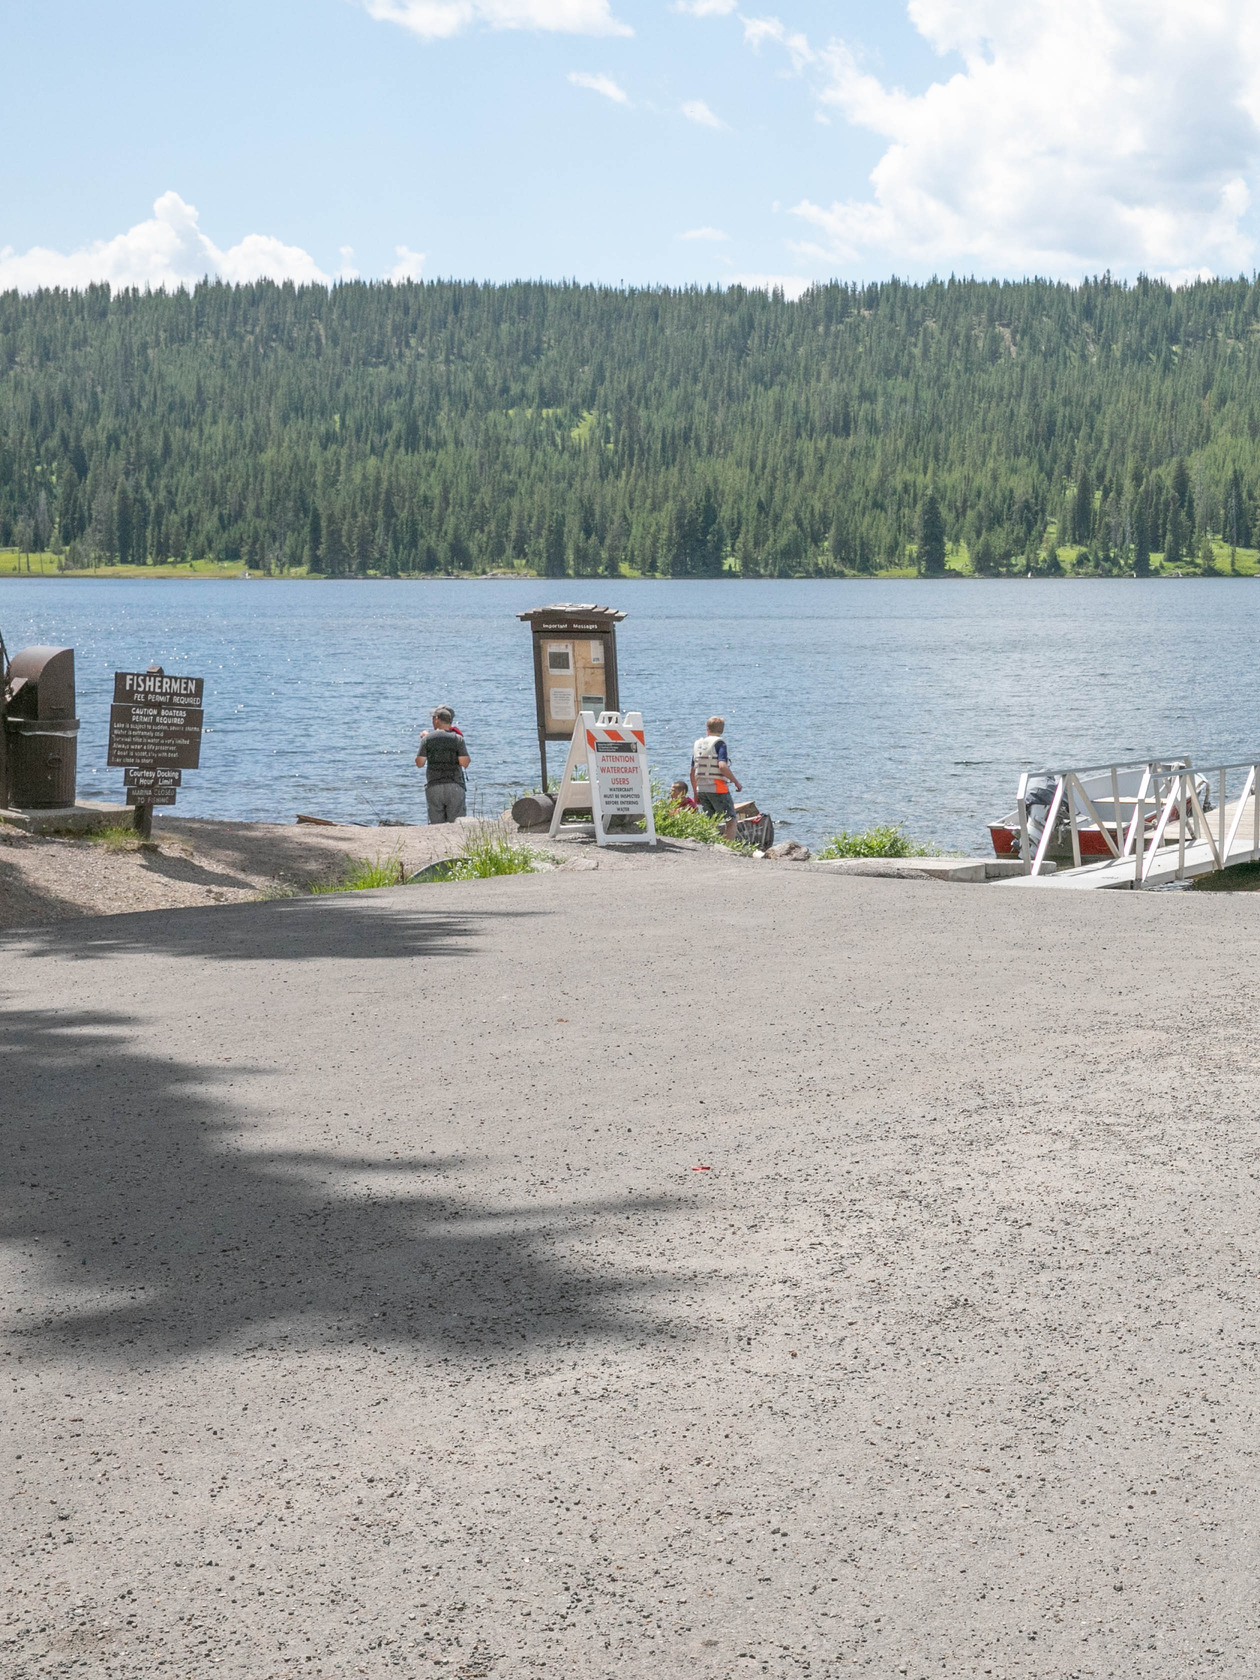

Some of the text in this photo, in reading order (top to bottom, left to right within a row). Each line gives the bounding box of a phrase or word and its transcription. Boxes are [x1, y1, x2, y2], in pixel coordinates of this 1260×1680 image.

[126, 675, 196, 694] FISHERMEN
[134, 693, 201, 705] FEE PERMIT REQUIRED
[132, 715, 153, 723] PERMIT
[601, 755, 635, 763] ATTENTION
[600, 766, 639, 774] WATERCRAFT
[129, 769, 179, 780] Courtesy Docking
[611, 777, 630, 785] USERS
